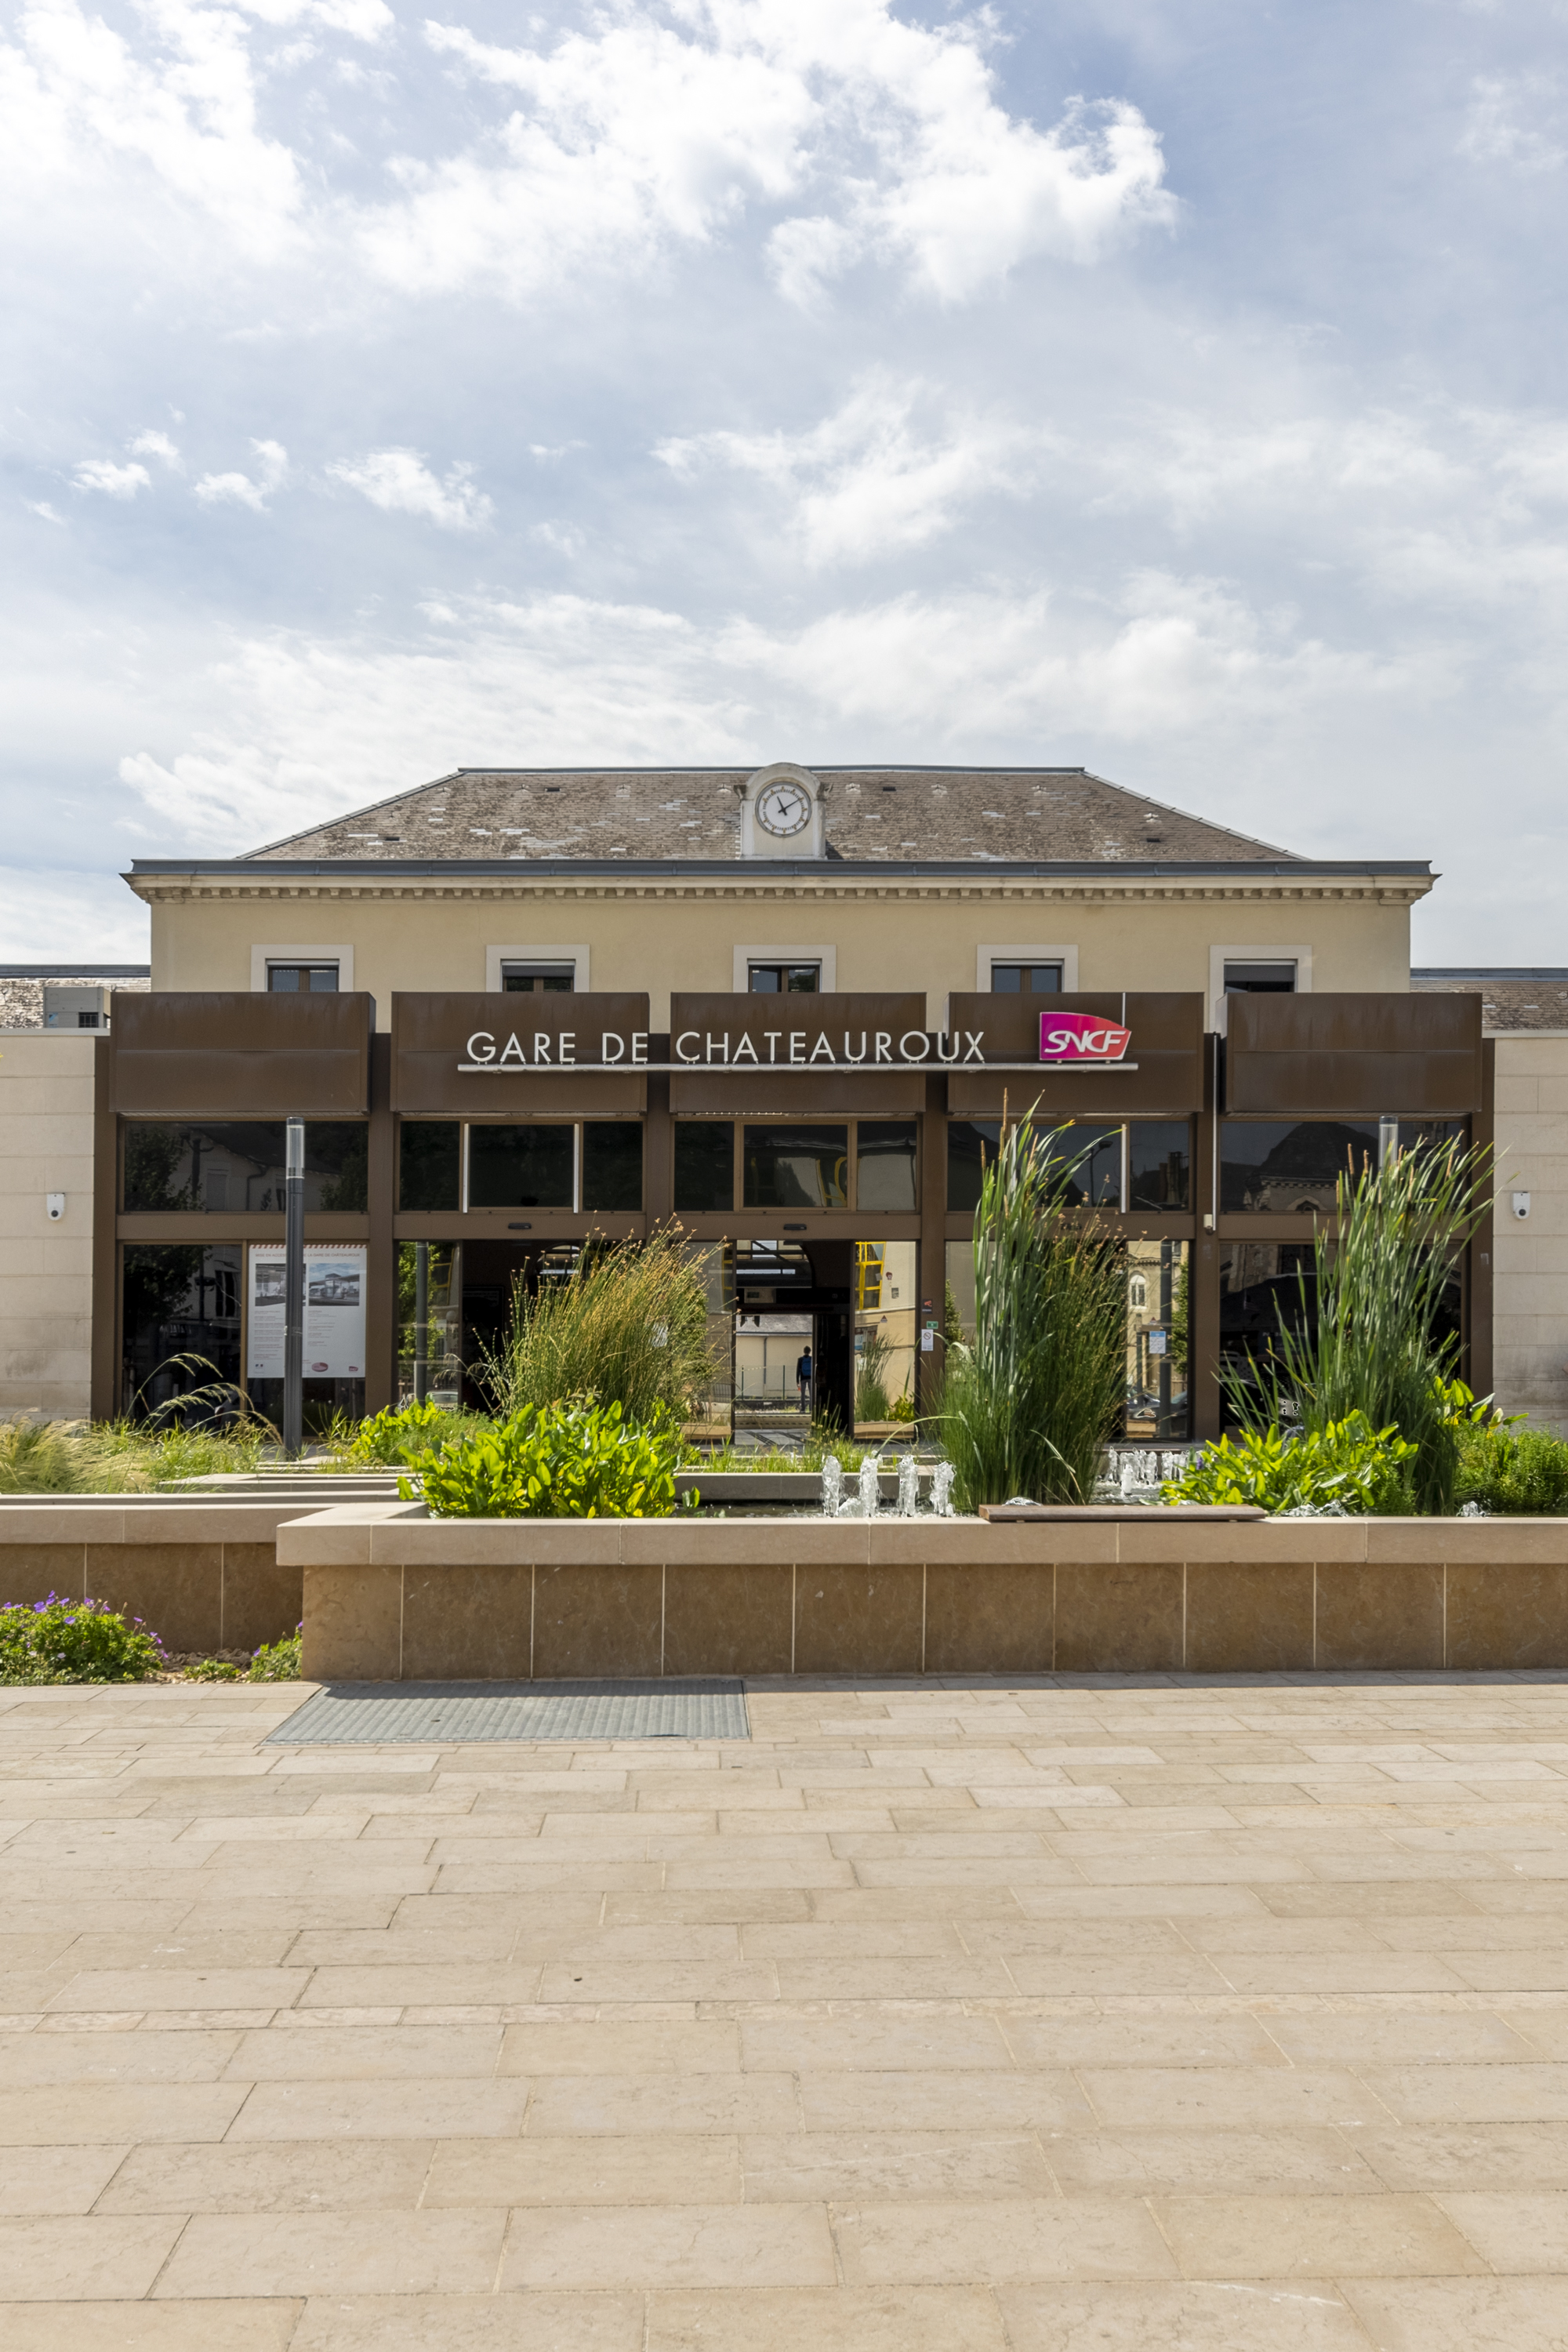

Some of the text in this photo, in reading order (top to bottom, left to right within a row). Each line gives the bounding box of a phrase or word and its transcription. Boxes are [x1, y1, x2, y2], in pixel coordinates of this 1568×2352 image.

[466, 1030, 985, 1062] GARE DE CHATEAUROUX
[1044, 1029, 1127, 1053] SNCF
